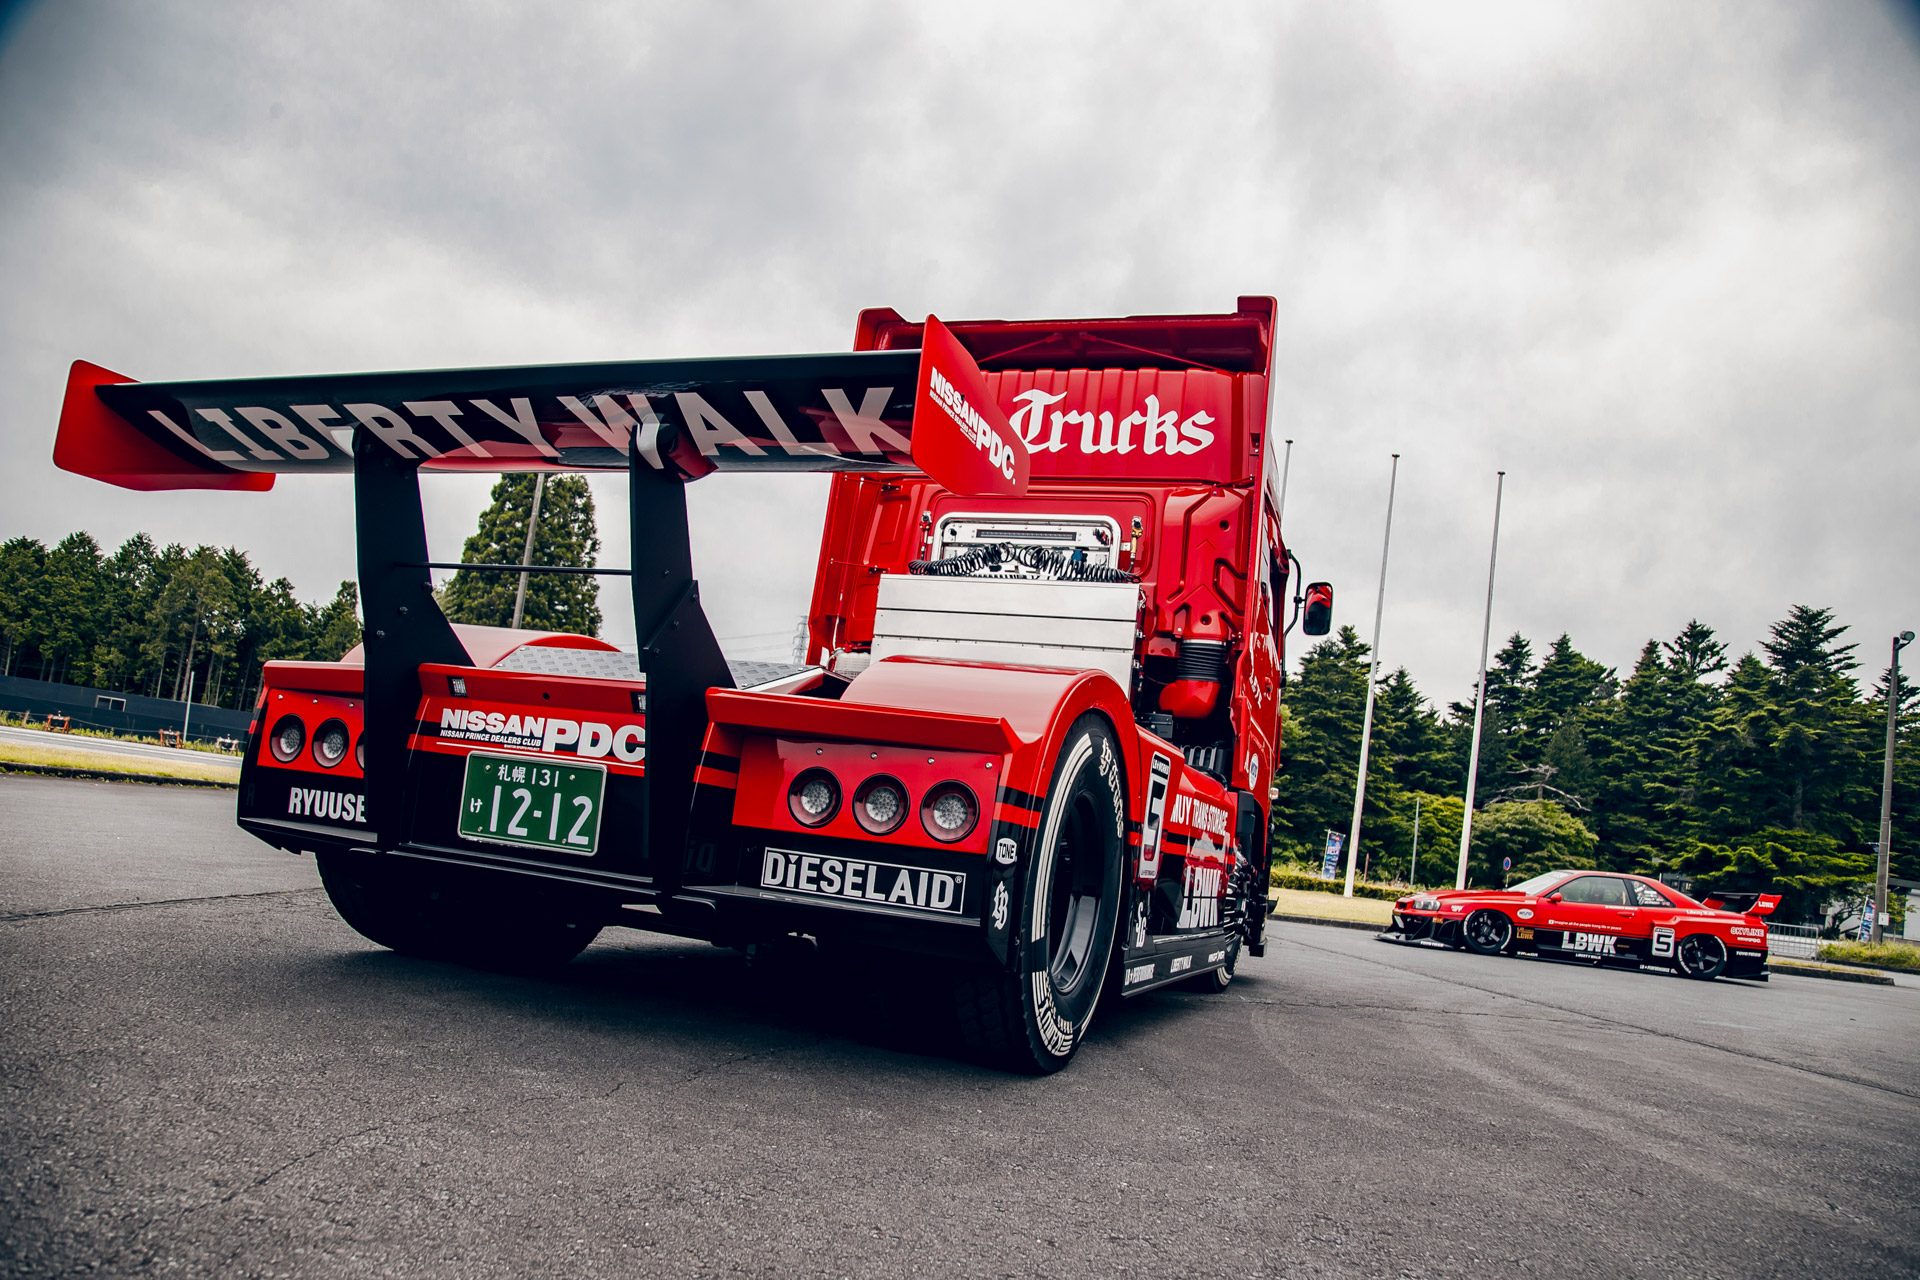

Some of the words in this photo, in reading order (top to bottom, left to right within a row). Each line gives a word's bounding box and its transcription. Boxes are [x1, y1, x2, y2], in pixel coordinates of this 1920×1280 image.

[930, 366, 980, 432] NISSAN
[147, 397, 563, 461] LIBERTY
[556, 387, 912, 460] WALK
[1009, 389, 1215, 455] Trucks
[440, 708, 545, 738] NISSAN
[542, 718, 645, 762] PDC
[440, 729, 465, 739] NISSAN
[464, 732, 490, 741] PRINCE
[490, 734, 522, 745] DEALERS
[522, 738, 541, 747] CLUB
[498, 764, 526, 784] 札幌
[531, 768, 560, 787] 131
[288, 787, 367, 823] RYUUSE
[470, 798, 483, 813] け
[489, 785, 593, 845] 12-12
[1144, 780, 1166, 861] 5
[998, 843, 1015, 859] TONE
[1176, 865, 1221, 929] LBWK
[1561, 931, 1617, 954] LBWK
[1654, 933, 1672, 953] 5
[1730, 926, 1764, 937] SKYLINE
